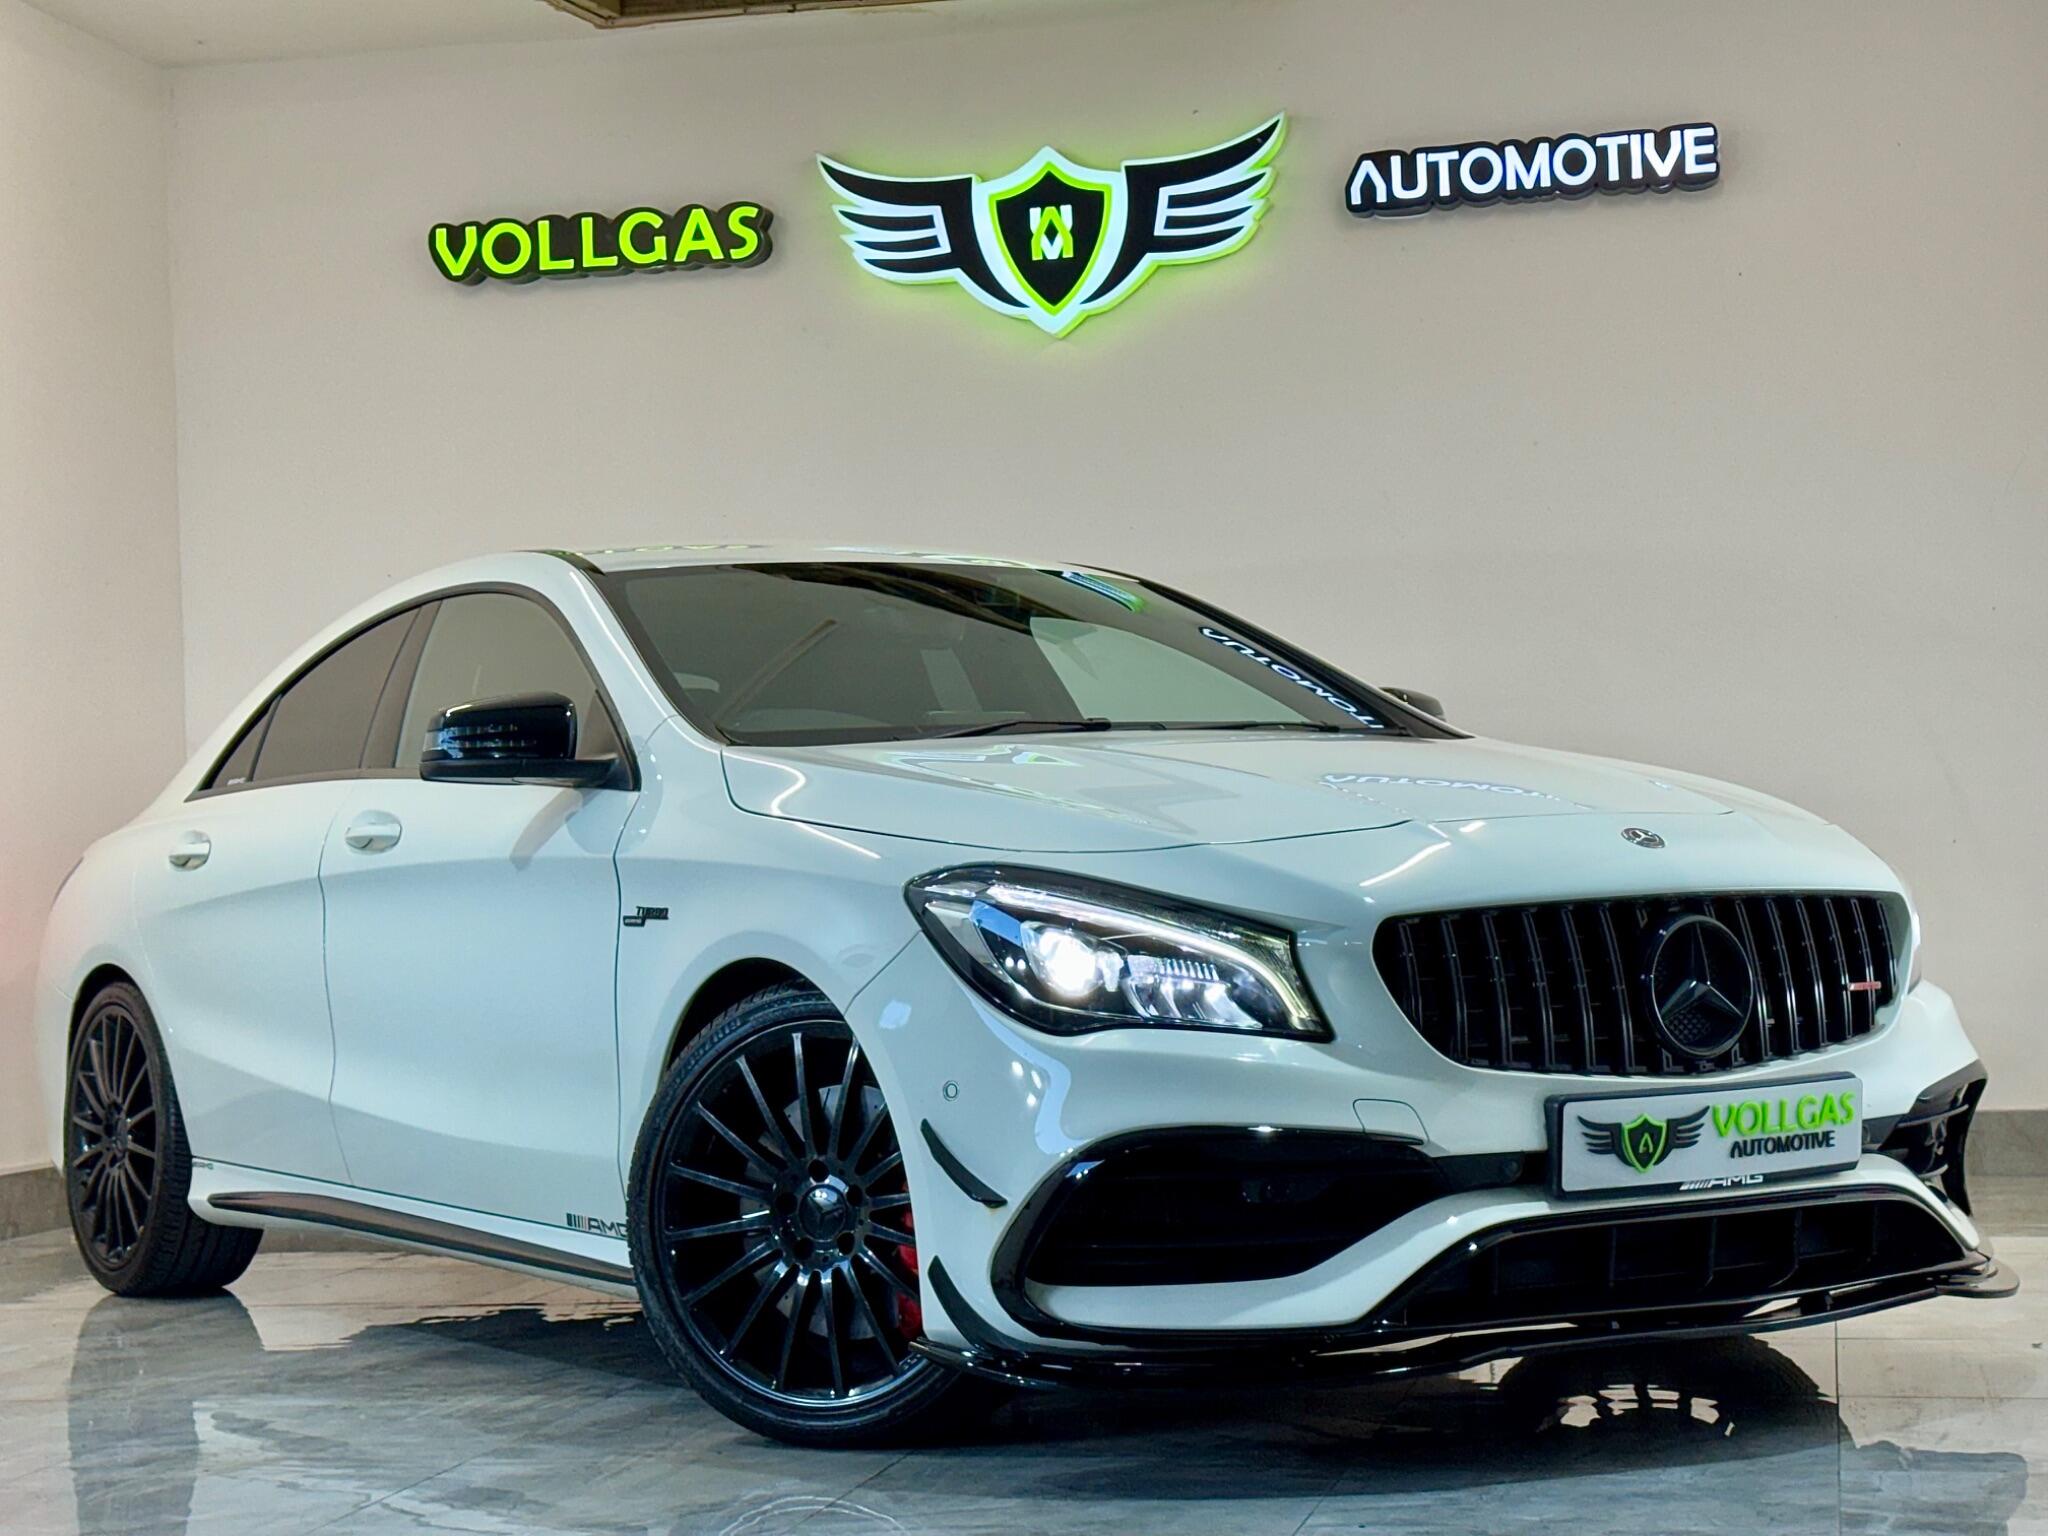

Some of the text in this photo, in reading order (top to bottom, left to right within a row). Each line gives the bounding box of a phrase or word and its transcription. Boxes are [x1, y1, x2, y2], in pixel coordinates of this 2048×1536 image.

[1350, 127, 1717, 206] AUTOMOTIVE
[434, 205, 760, 277] VOLLGAS
[1712, 1091, 1856, 1138] VOLLGAS
[1729, 1130, 1836, 1159] AUTOMOTIVE
